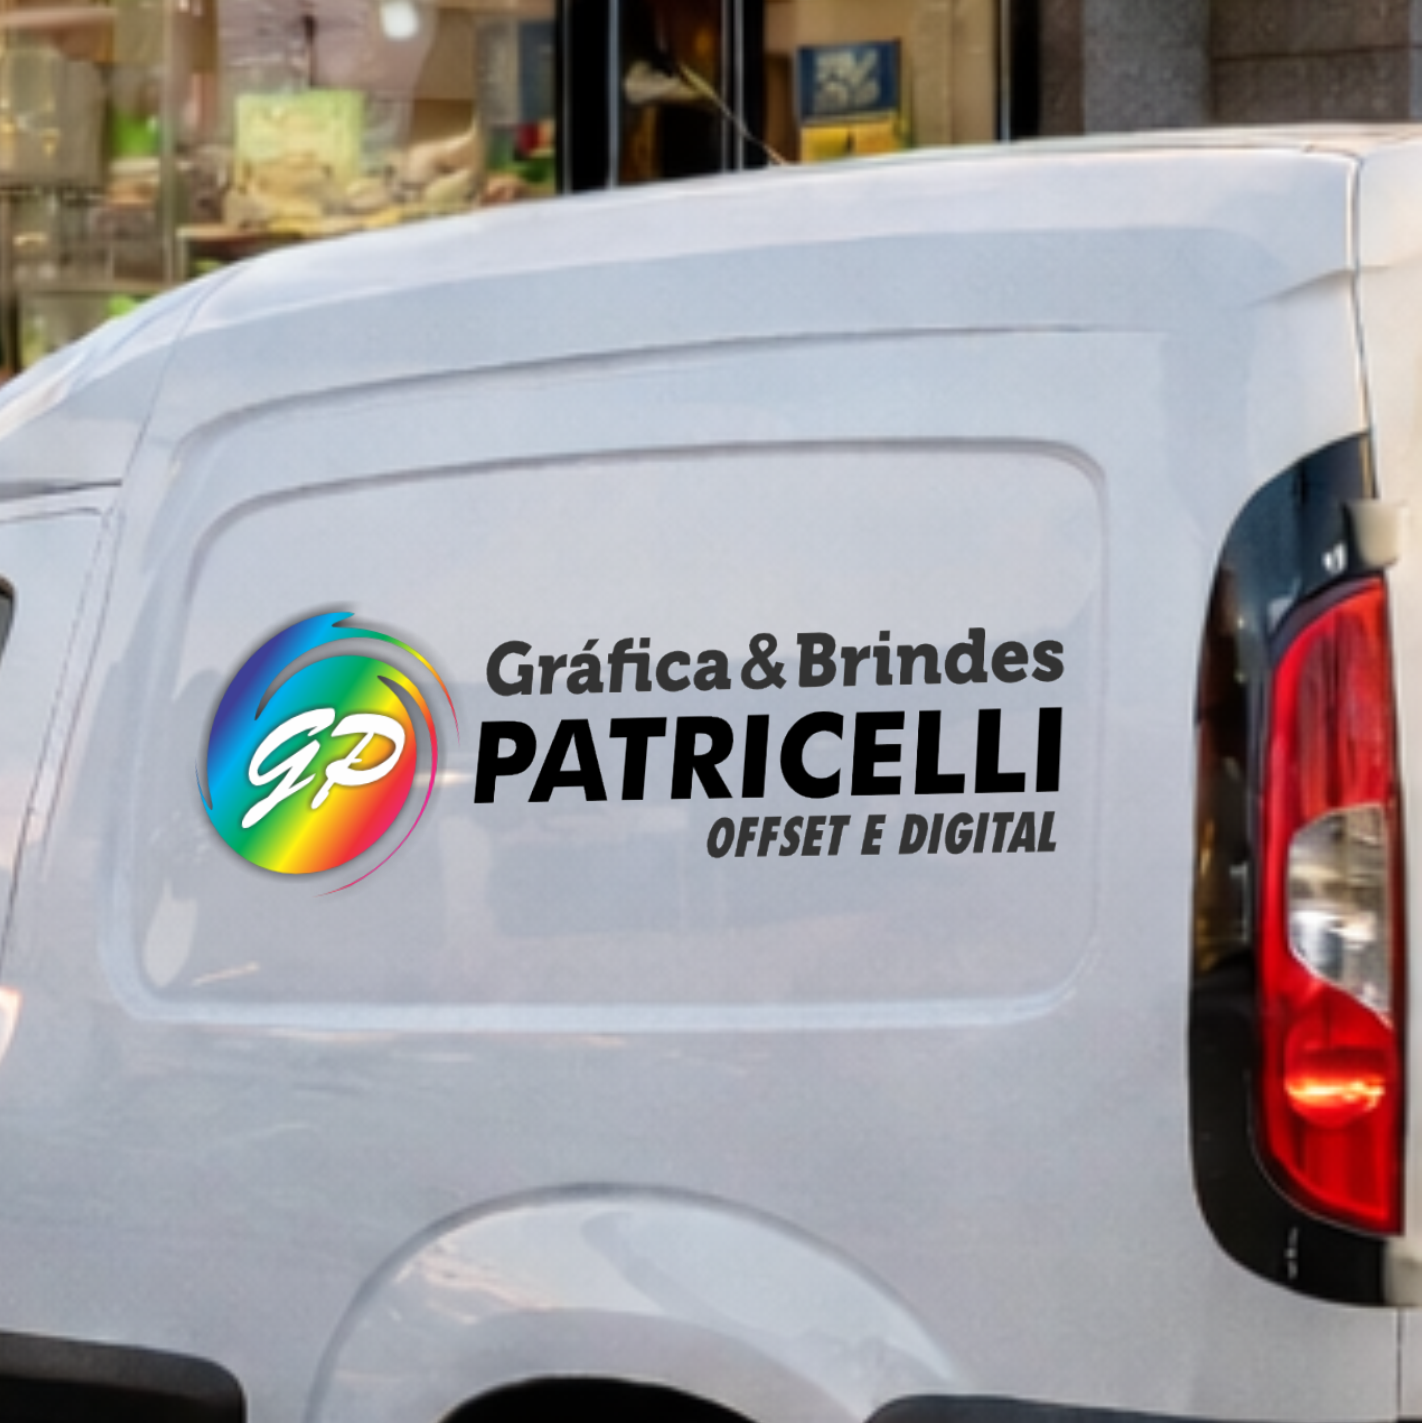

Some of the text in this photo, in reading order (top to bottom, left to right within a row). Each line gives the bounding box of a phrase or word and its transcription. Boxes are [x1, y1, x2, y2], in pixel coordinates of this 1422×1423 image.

[485, 636, 733, 697] Gráfica
[796, 626, 1066, 688] Brindes
[473, 705, 1064, 805] PATRICELLI
[705, 810, 1059, 859] OFFSET E DIGITAL
